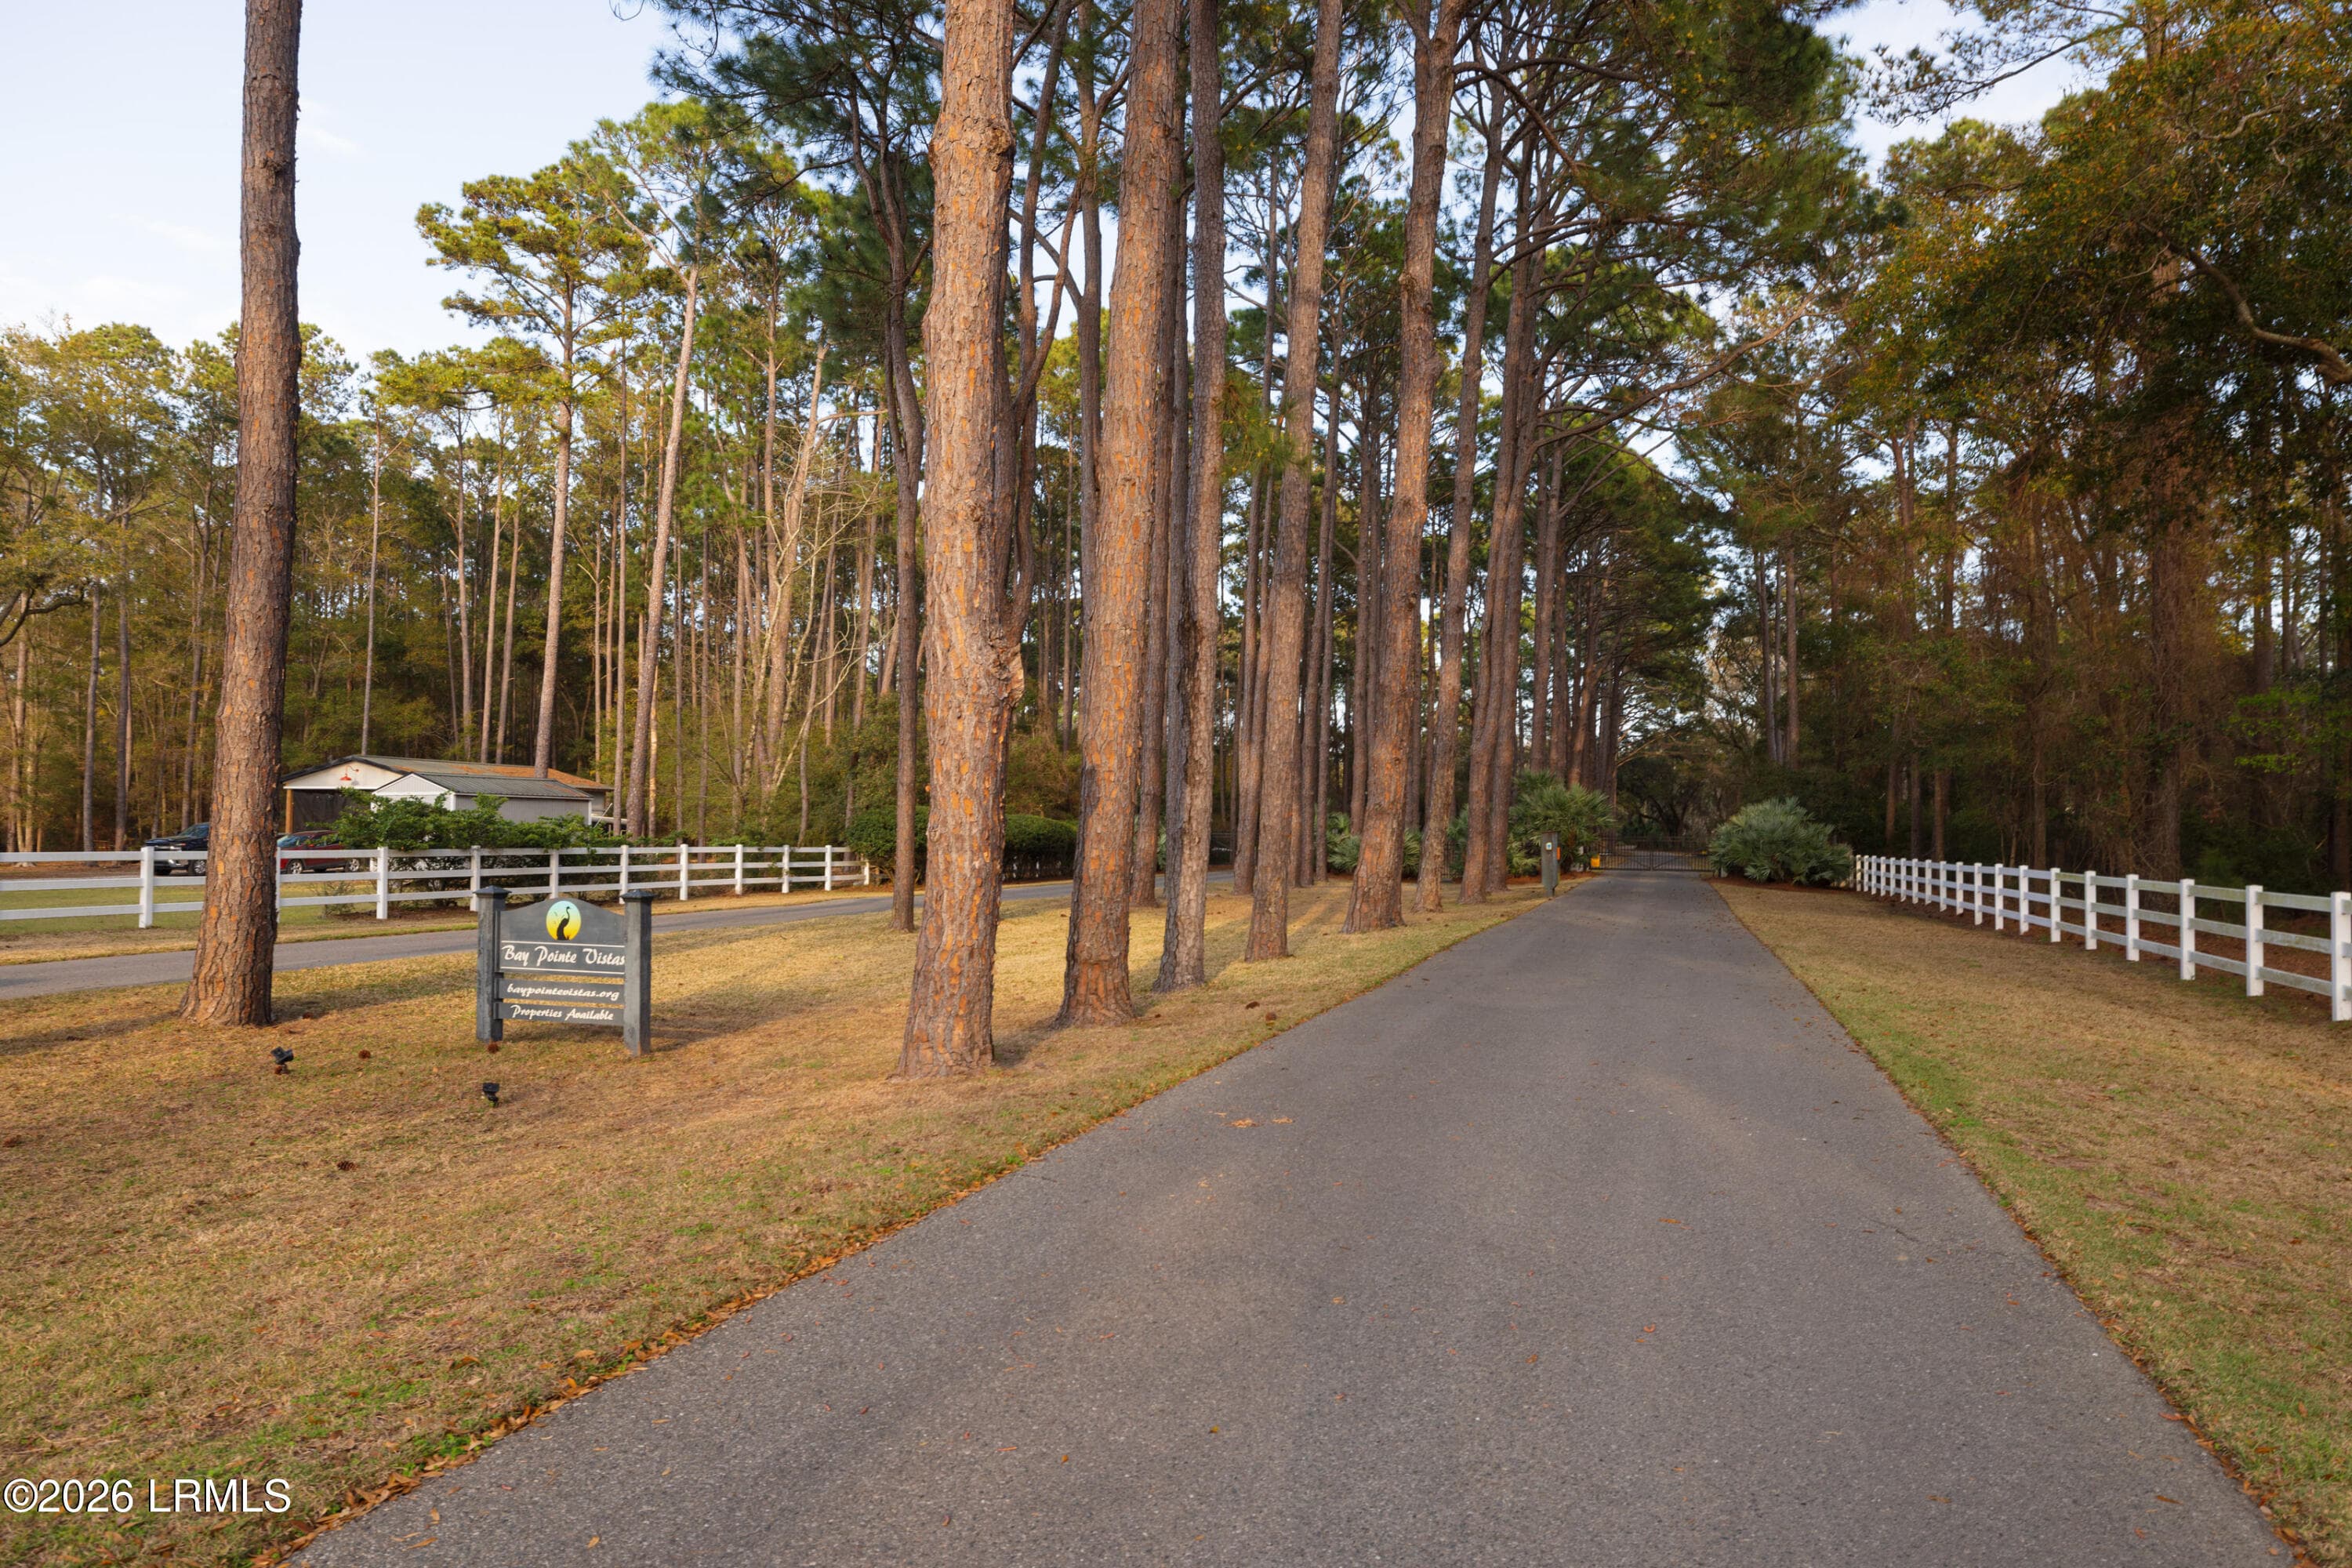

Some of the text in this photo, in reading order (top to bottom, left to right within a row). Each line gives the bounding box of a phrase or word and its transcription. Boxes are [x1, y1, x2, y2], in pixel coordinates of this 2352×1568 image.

[502, 945, 625, 967] Bay Pointe Vistas
[506, 984, 619, 1001] baypointevistas.org
[510, 1004, 614, 1021] Properties Available
